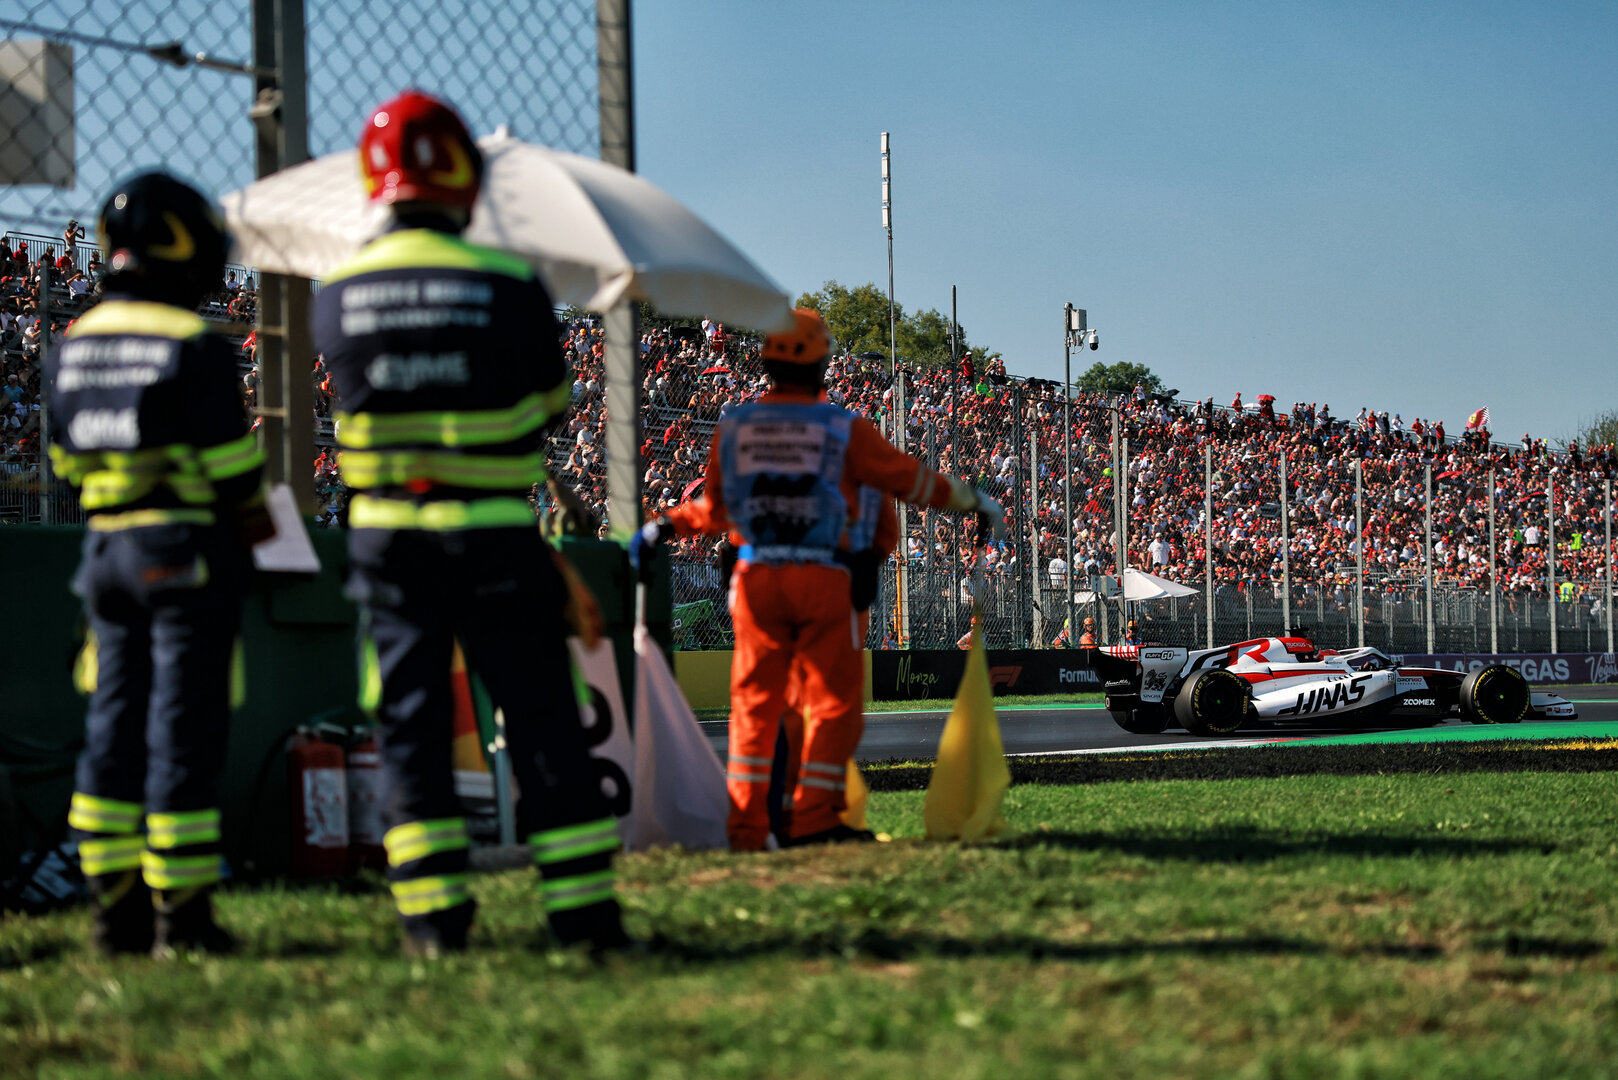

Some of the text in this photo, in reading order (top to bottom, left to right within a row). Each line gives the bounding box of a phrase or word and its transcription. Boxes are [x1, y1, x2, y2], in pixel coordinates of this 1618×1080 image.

[1161, 651, 1174, 660] GO
[896, 655, 938, 698] Monza
[1403, 698, 1436, 706] ZOOMEX
